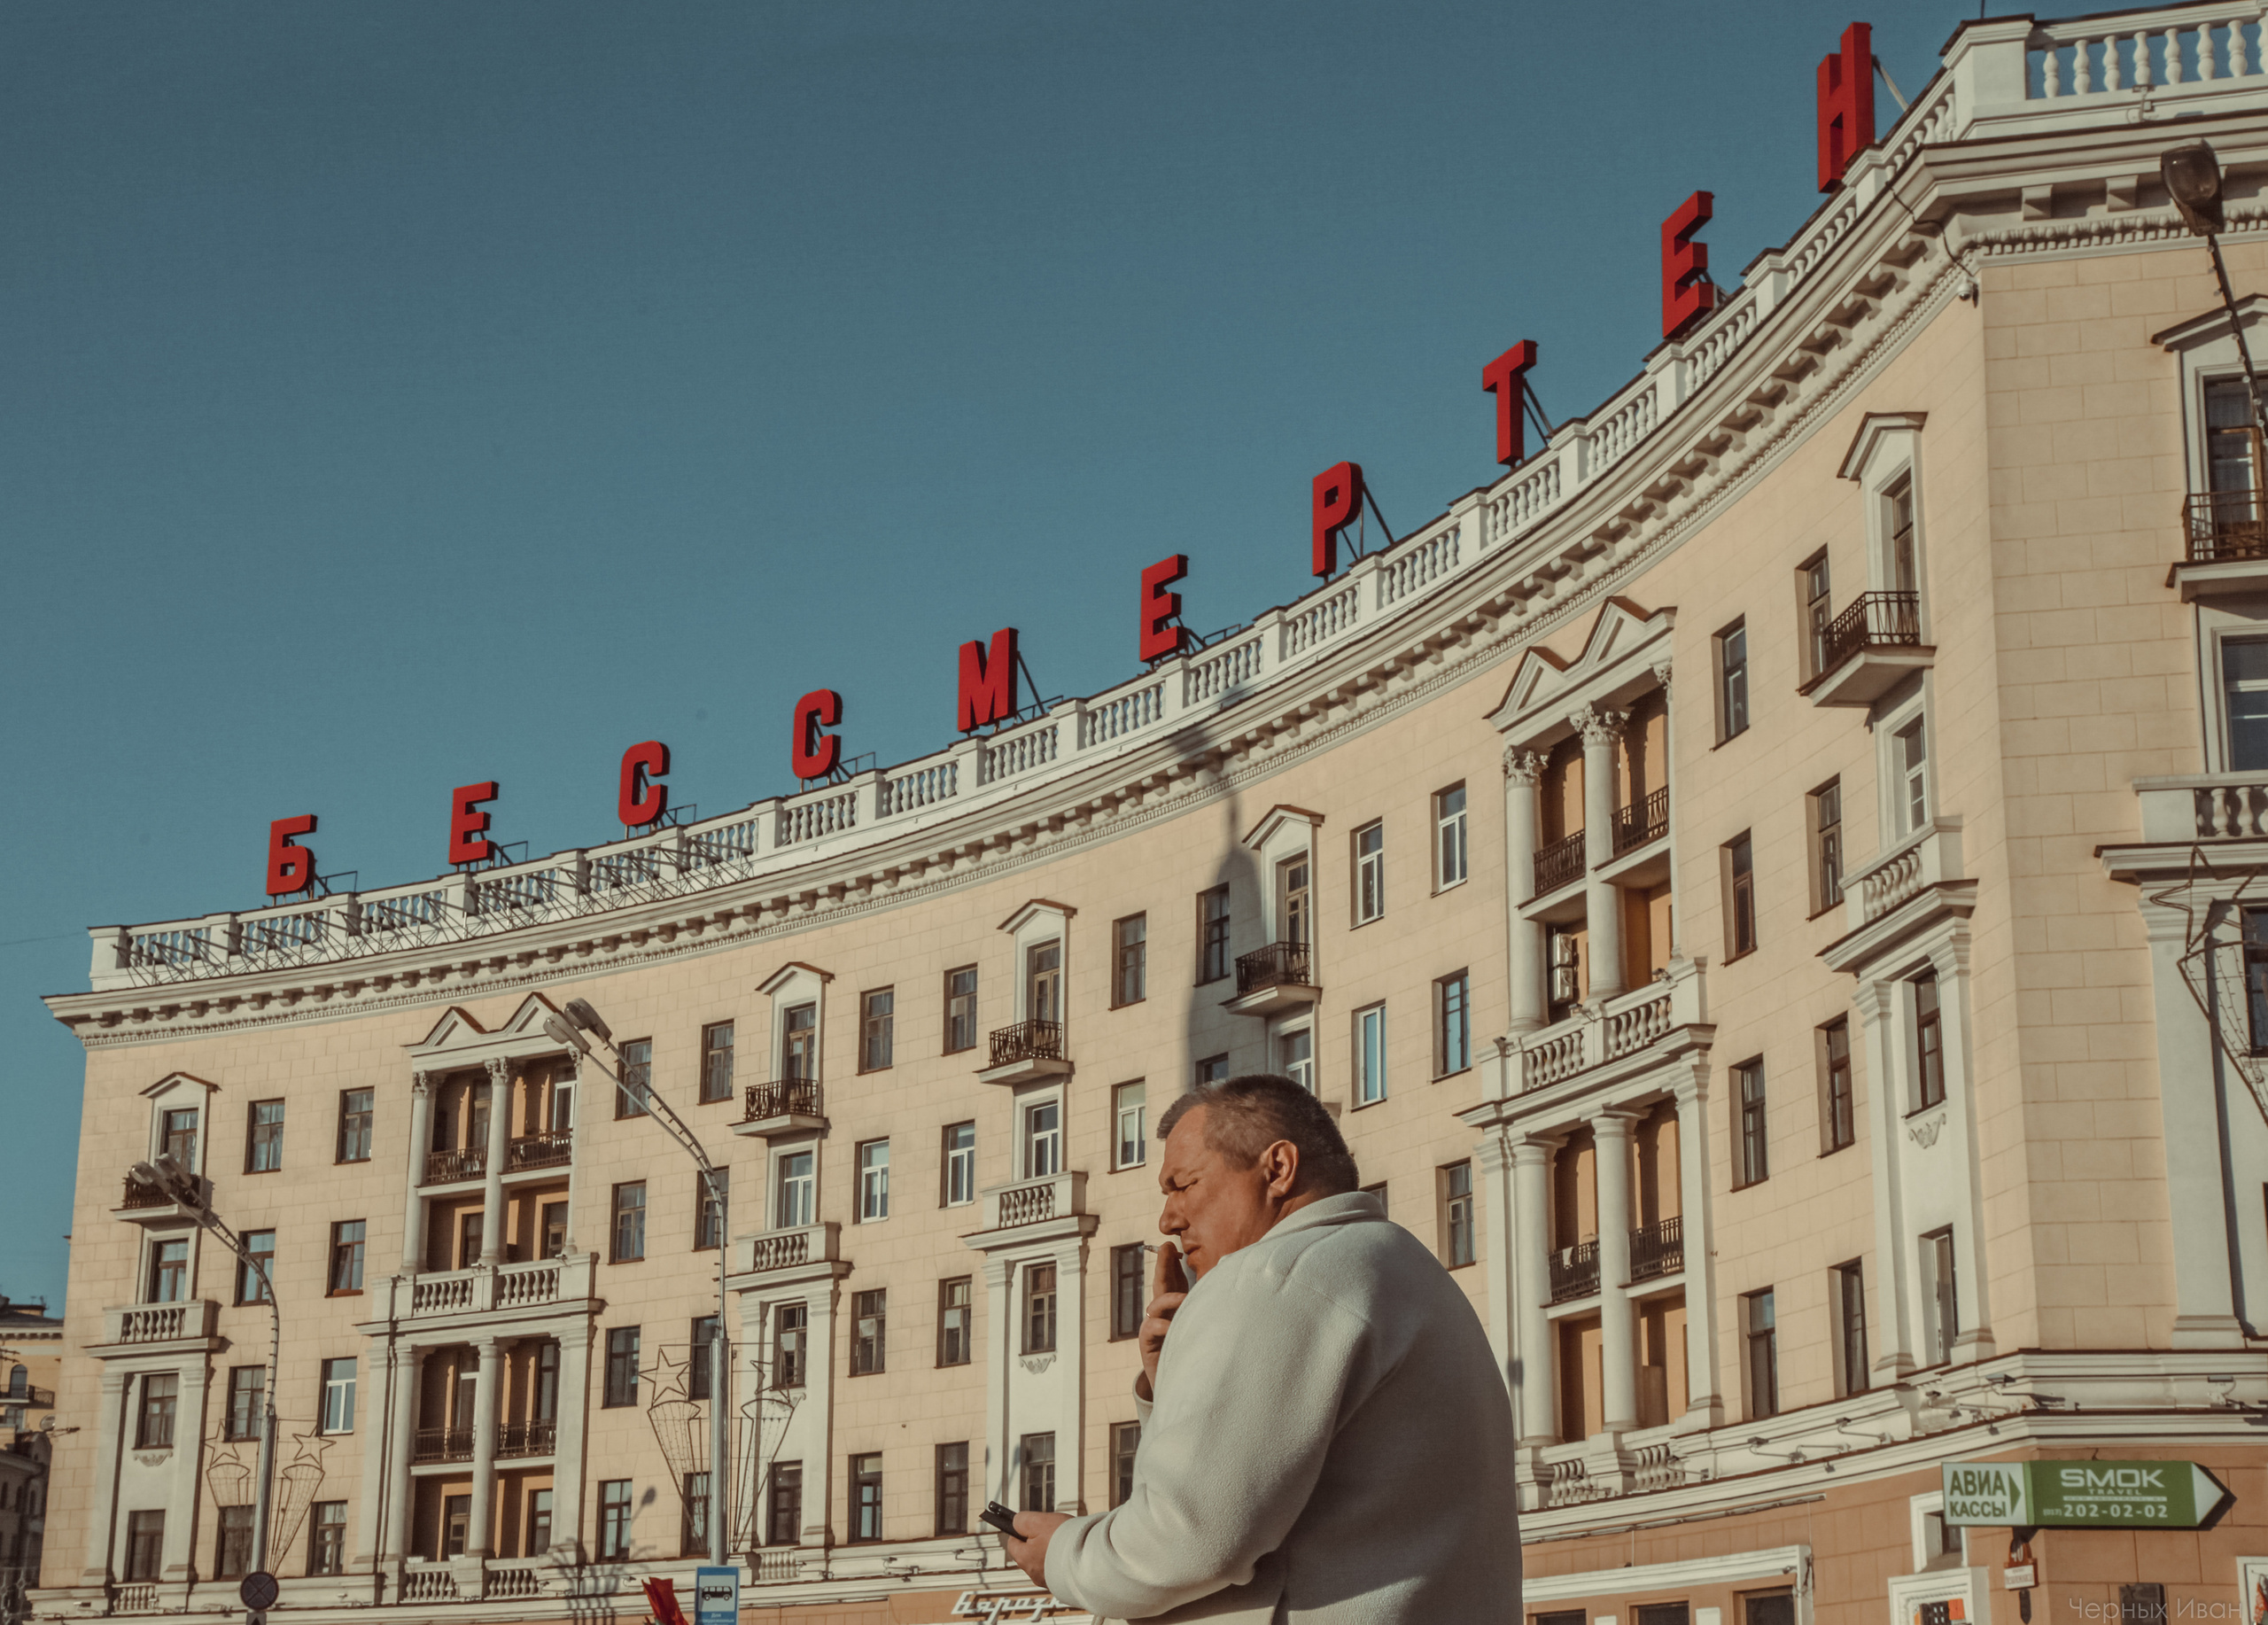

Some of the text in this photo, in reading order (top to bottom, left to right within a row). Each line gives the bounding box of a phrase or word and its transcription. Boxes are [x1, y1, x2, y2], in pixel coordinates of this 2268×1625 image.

[266, 22, 1876, 896] БЕССМЕРТЕН
[1949, 1470, 2007, 1497] АВИА
[2060, 1468, 2165, 1488] SMOK
[1949, 1500, 2007, 1518] КАССЫ
[2063, 1504, 2168, 1518] 202-02-02
